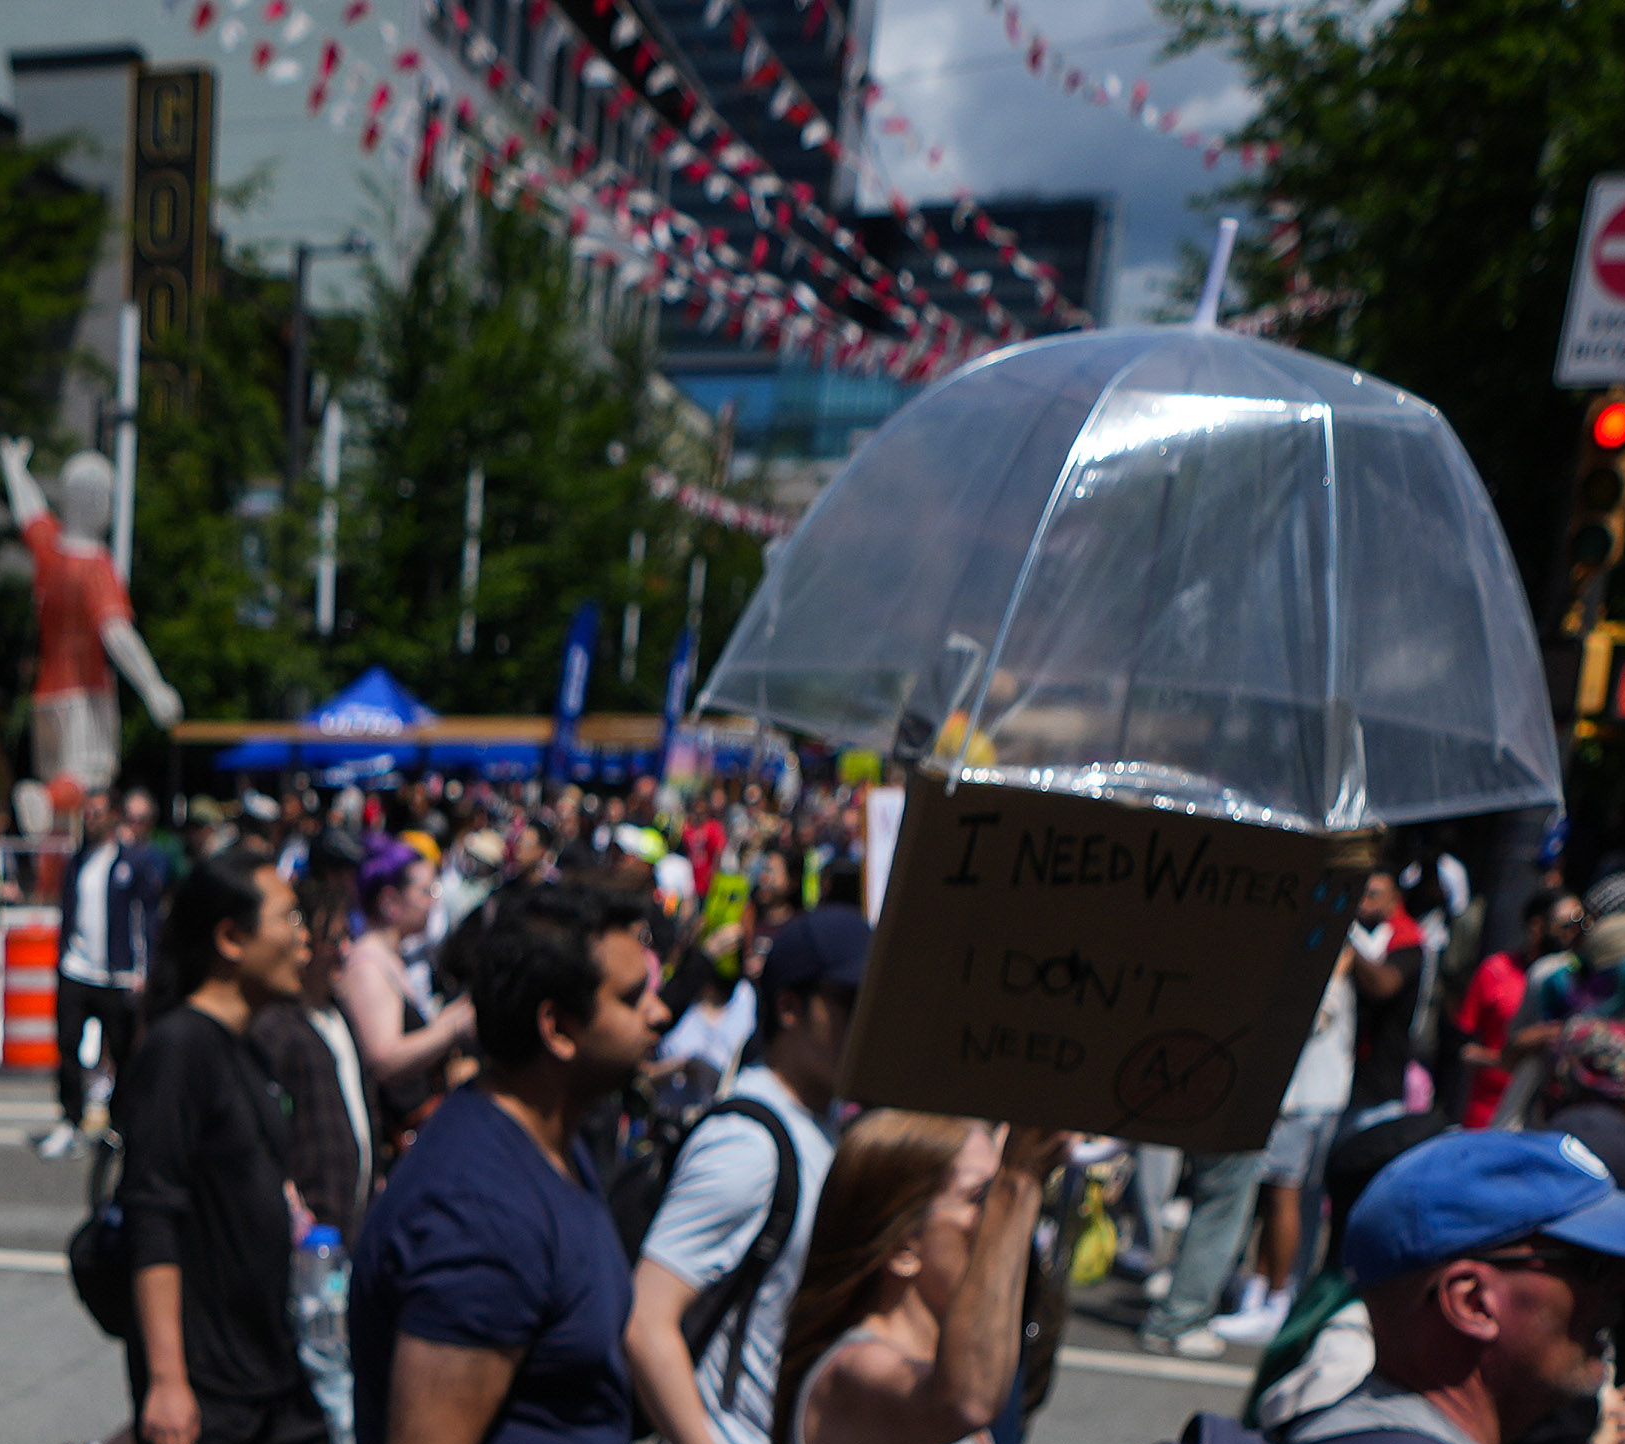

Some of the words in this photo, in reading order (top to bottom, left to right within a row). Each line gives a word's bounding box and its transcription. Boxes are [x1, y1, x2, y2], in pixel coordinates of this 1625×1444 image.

[943, 812, 1002, 888] I
[1010, 826, 1136, 890] NEED
[1144, 830, 1302, 912] WATER
[1002, 948, 1192, 1014] DON'T
[961, 1022, 1087, 1073] NEED
